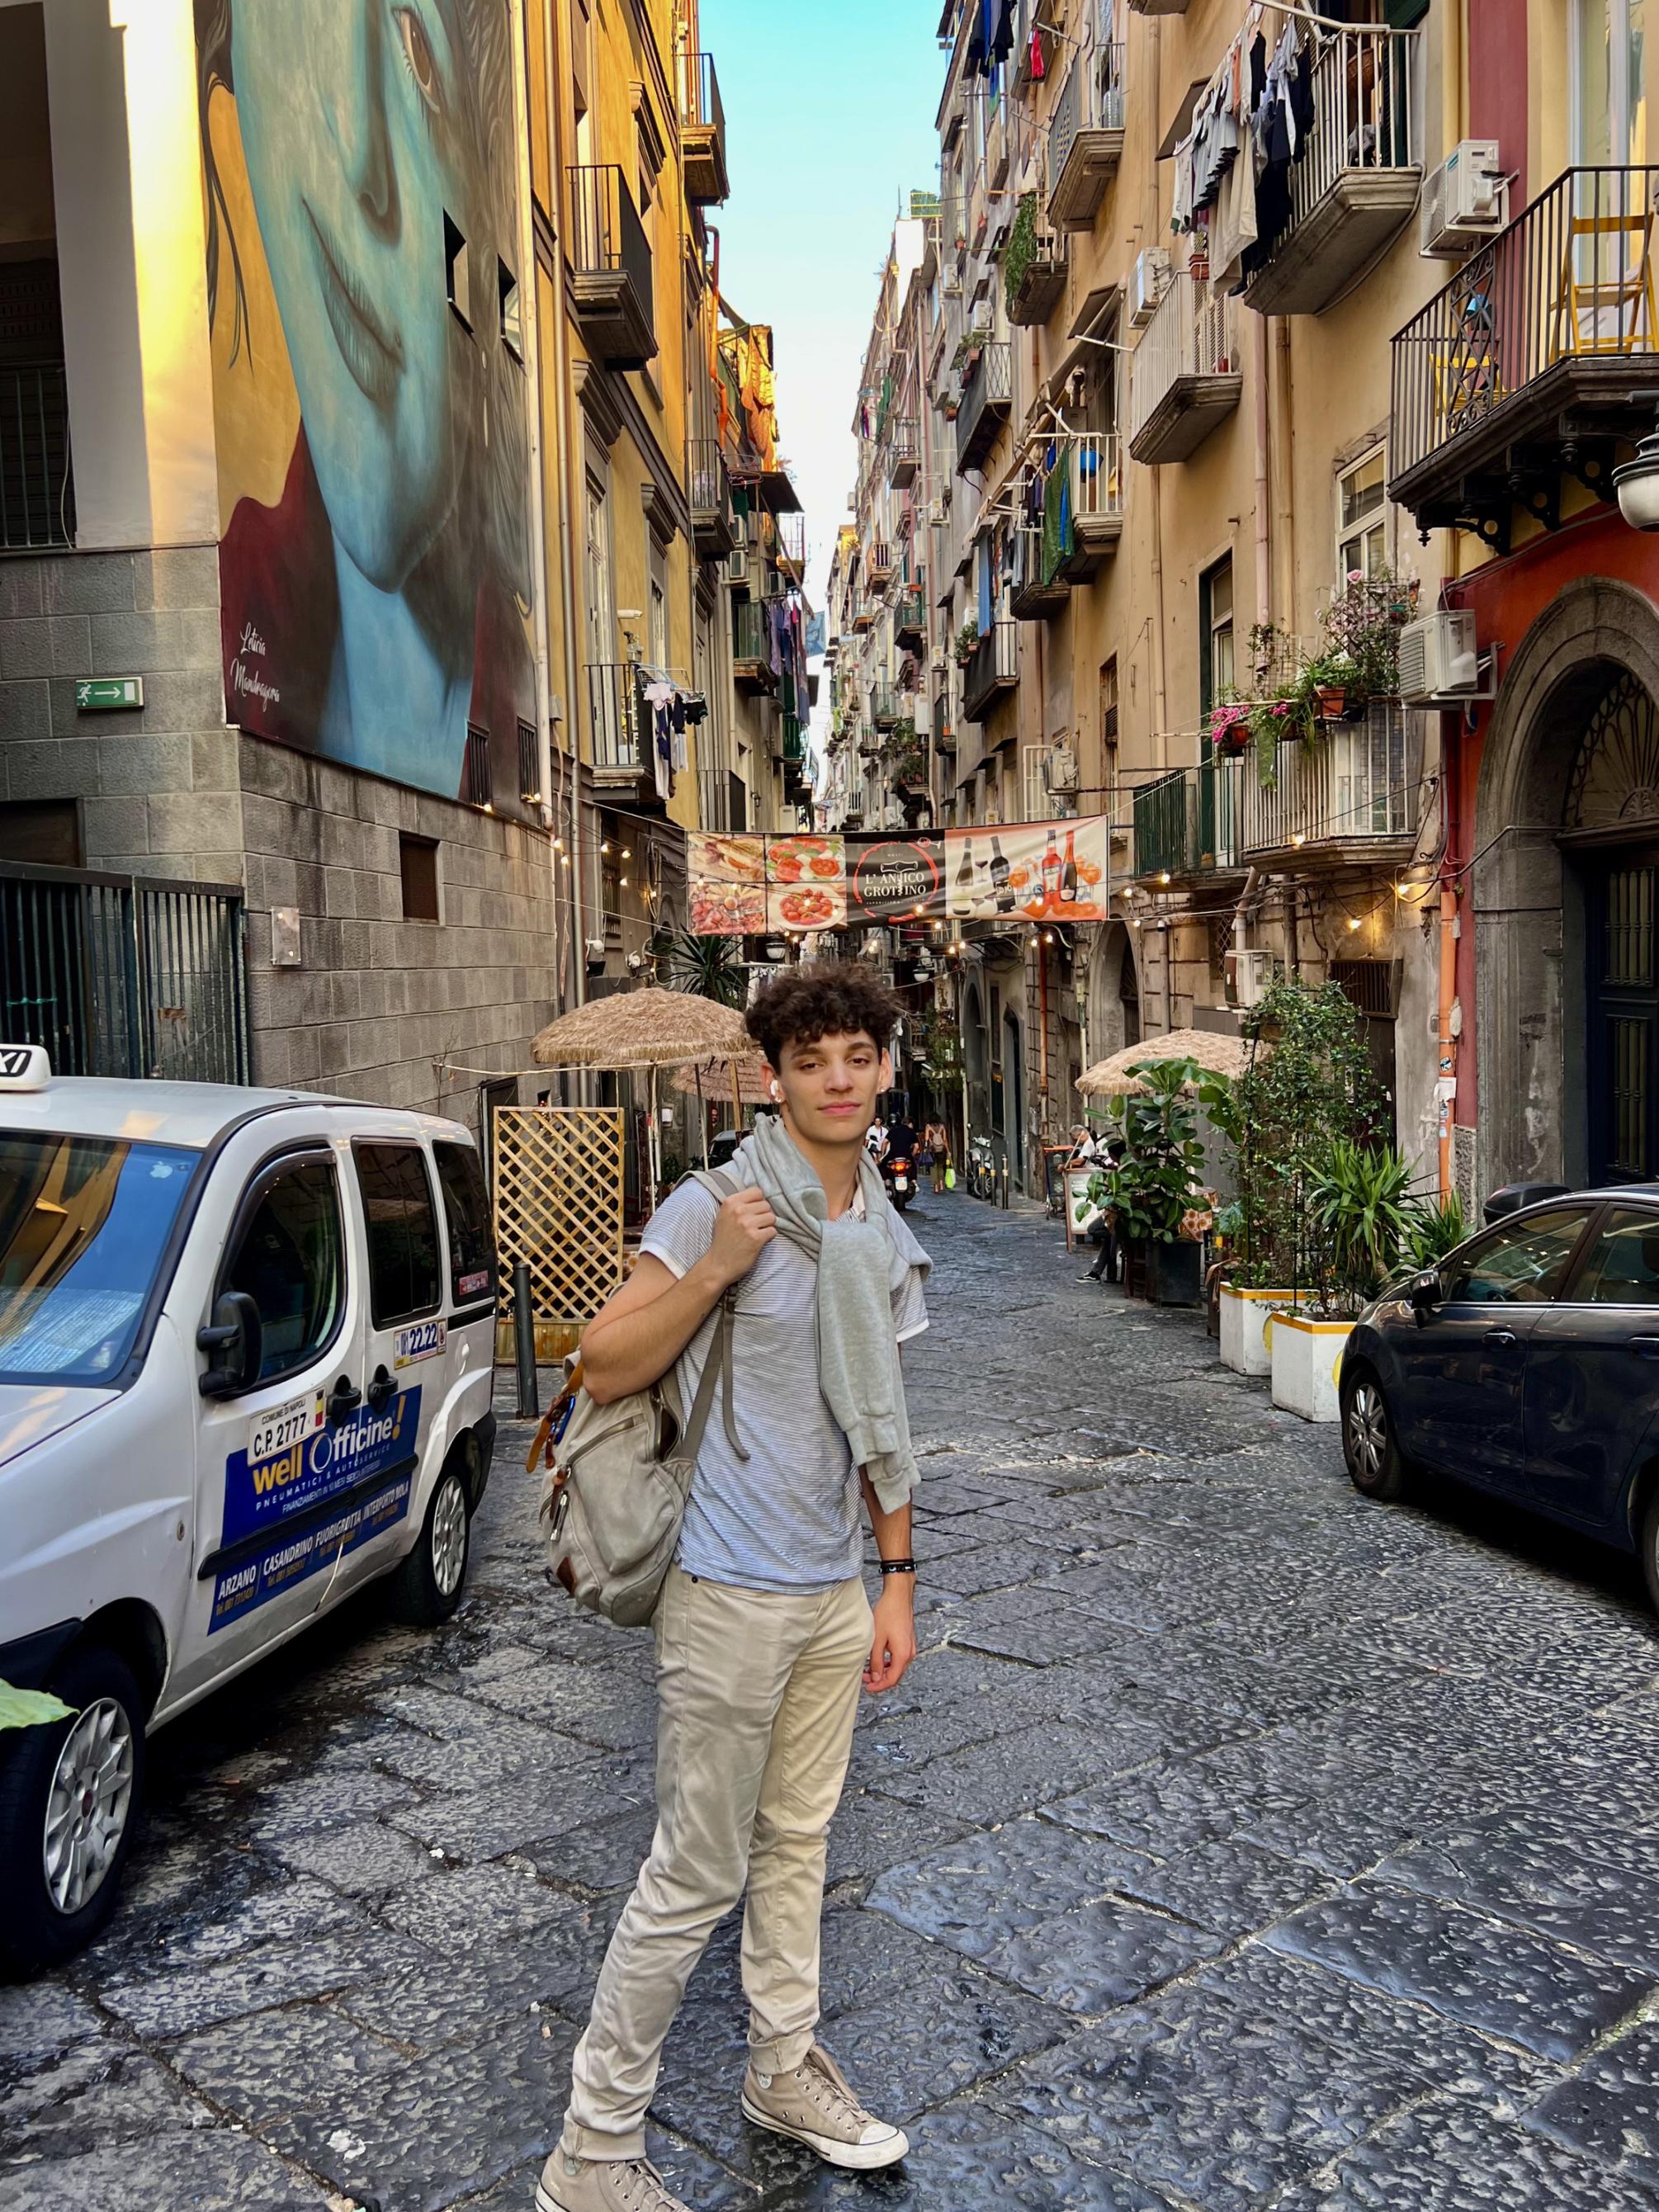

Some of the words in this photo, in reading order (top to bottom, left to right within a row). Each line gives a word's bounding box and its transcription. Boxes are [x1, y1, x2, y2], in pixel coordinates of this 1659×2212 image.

[863, 884, 927, 897] GROTTINO
[262, 1411, 284, 1425] COMUNE
[290, 1398, 306, 1412] NAPOLI
[254, 1429, 273, 1458] C.P.
[276, 1411, 307, 1449] 2777
[253, 1443, 303, 1496] well
[255, 1478, 323, 1511] PNEUMATICI
[314, 1509, 362, 1548] FUORIGROTTA
[262, 1535, 314, 1576] CASANDRINO
[218, 1564, 257, 1600] ARZANO
